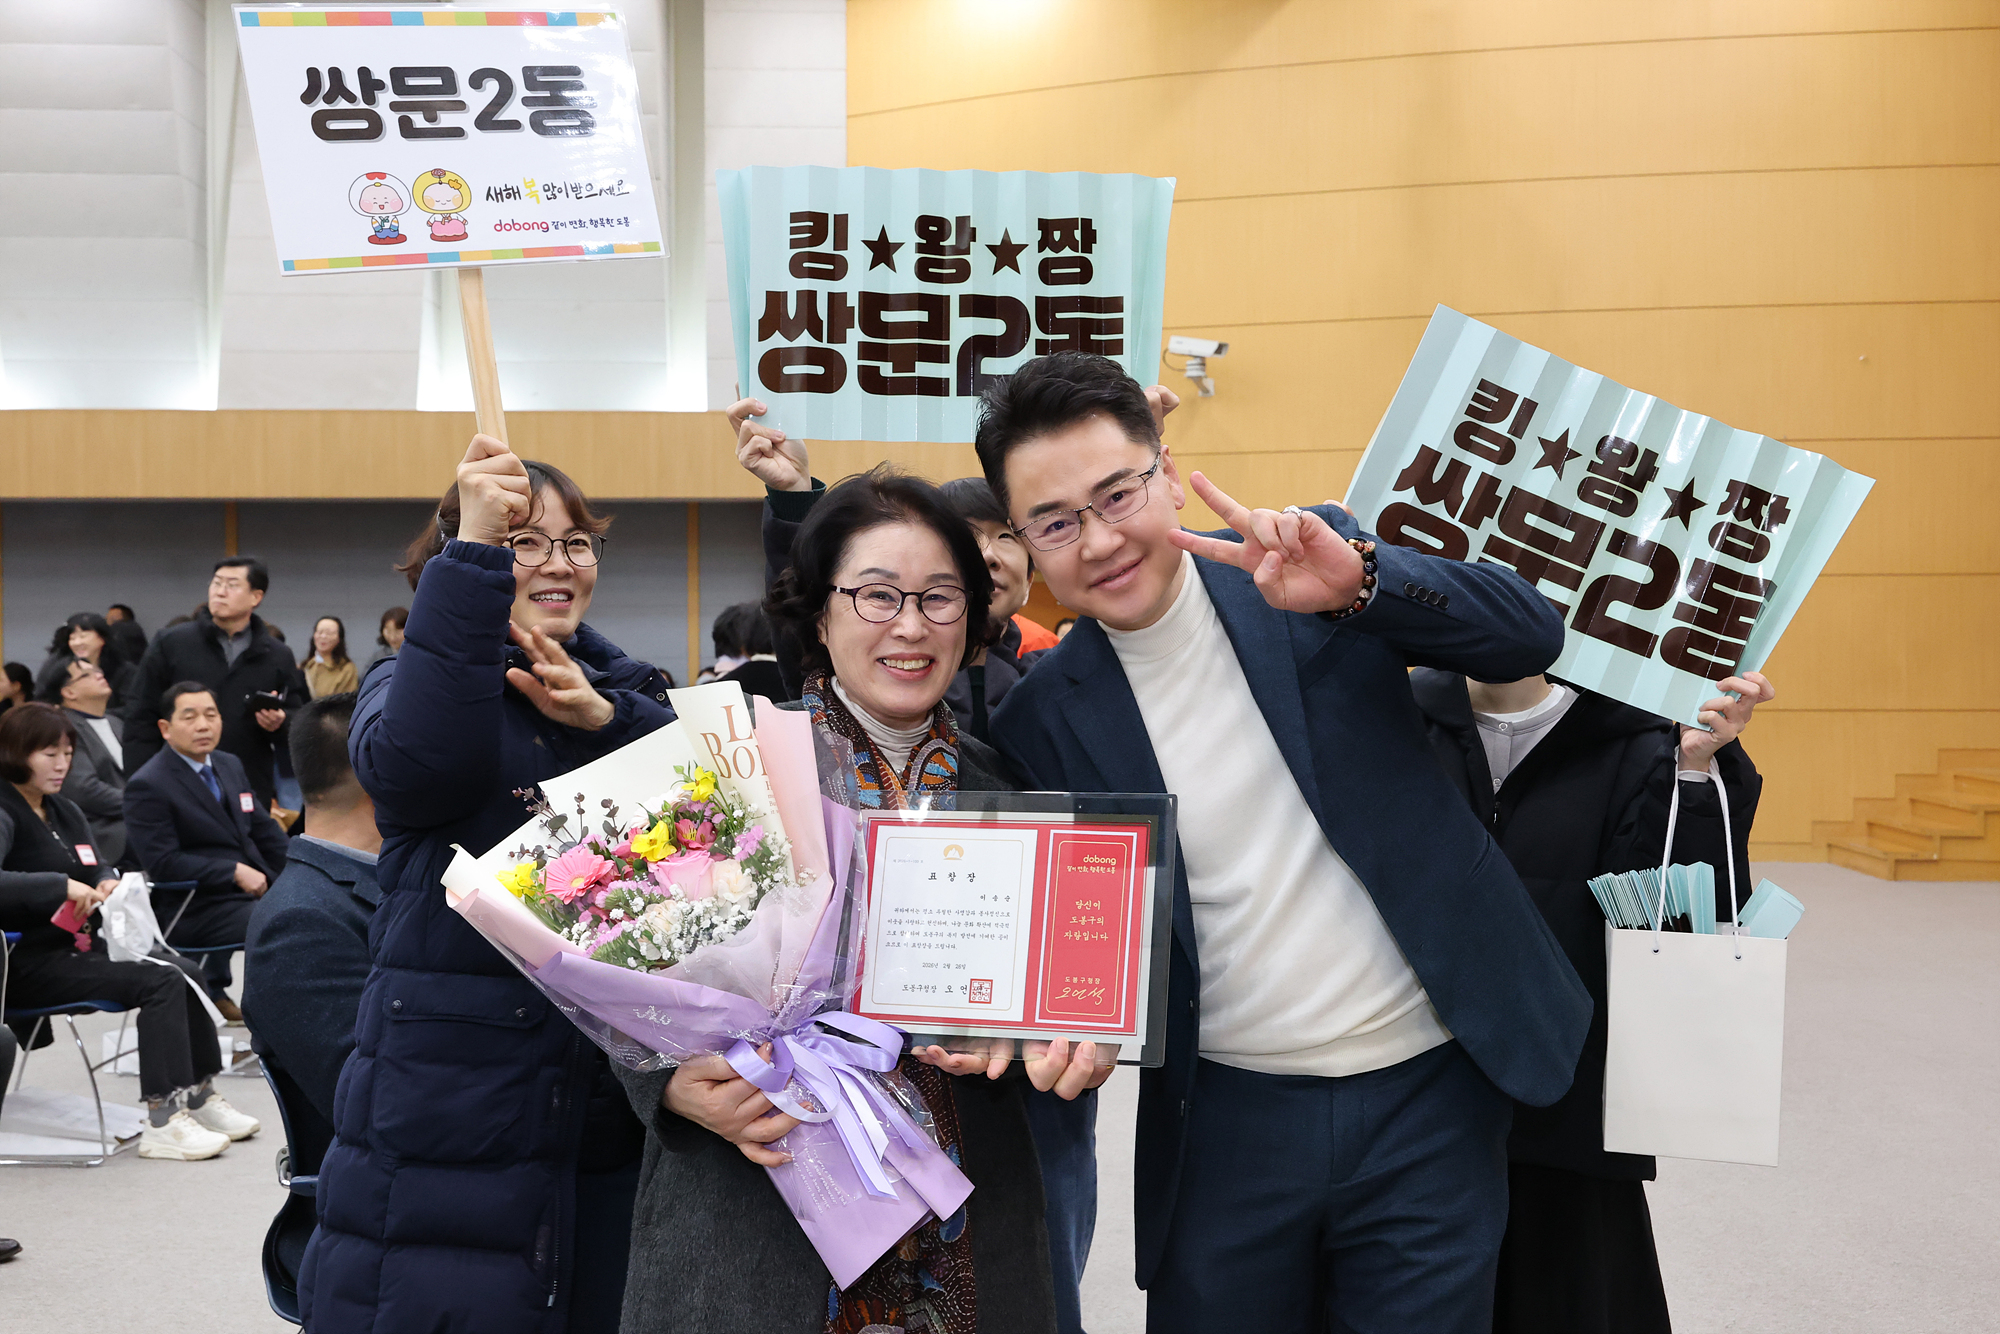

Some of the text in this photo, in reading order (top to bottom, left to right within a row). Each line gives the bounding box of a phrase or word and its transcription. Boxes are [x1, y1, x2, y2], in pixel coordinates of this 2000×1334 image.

[300, 65, 597, 141] 쌍문2동
[486, 177, 630, 204] 새해 복 많이 받으세요
[494, 219, 550, 232] dobong
[551, 220, 567, 230] 같이
[589, 217, 615, 228] 행복한
[616, 216, 630, 228] 도봉
[788, 211, 1097, 286] 킹 왕 짱
[1453, 378, 1791, 564] 킹 왕 짱
[1083, 854, 1117, 866] dobong
[1075, 899, 1101, 911] 당신이
[1069, 915, 1105, 926] 도봉구의
[1063, 930, 1109, 941] 자랑입니다
[1065, 976, 1101, 985] 도봉구청장
[902, 984, 937, 994] 도봉구청장
